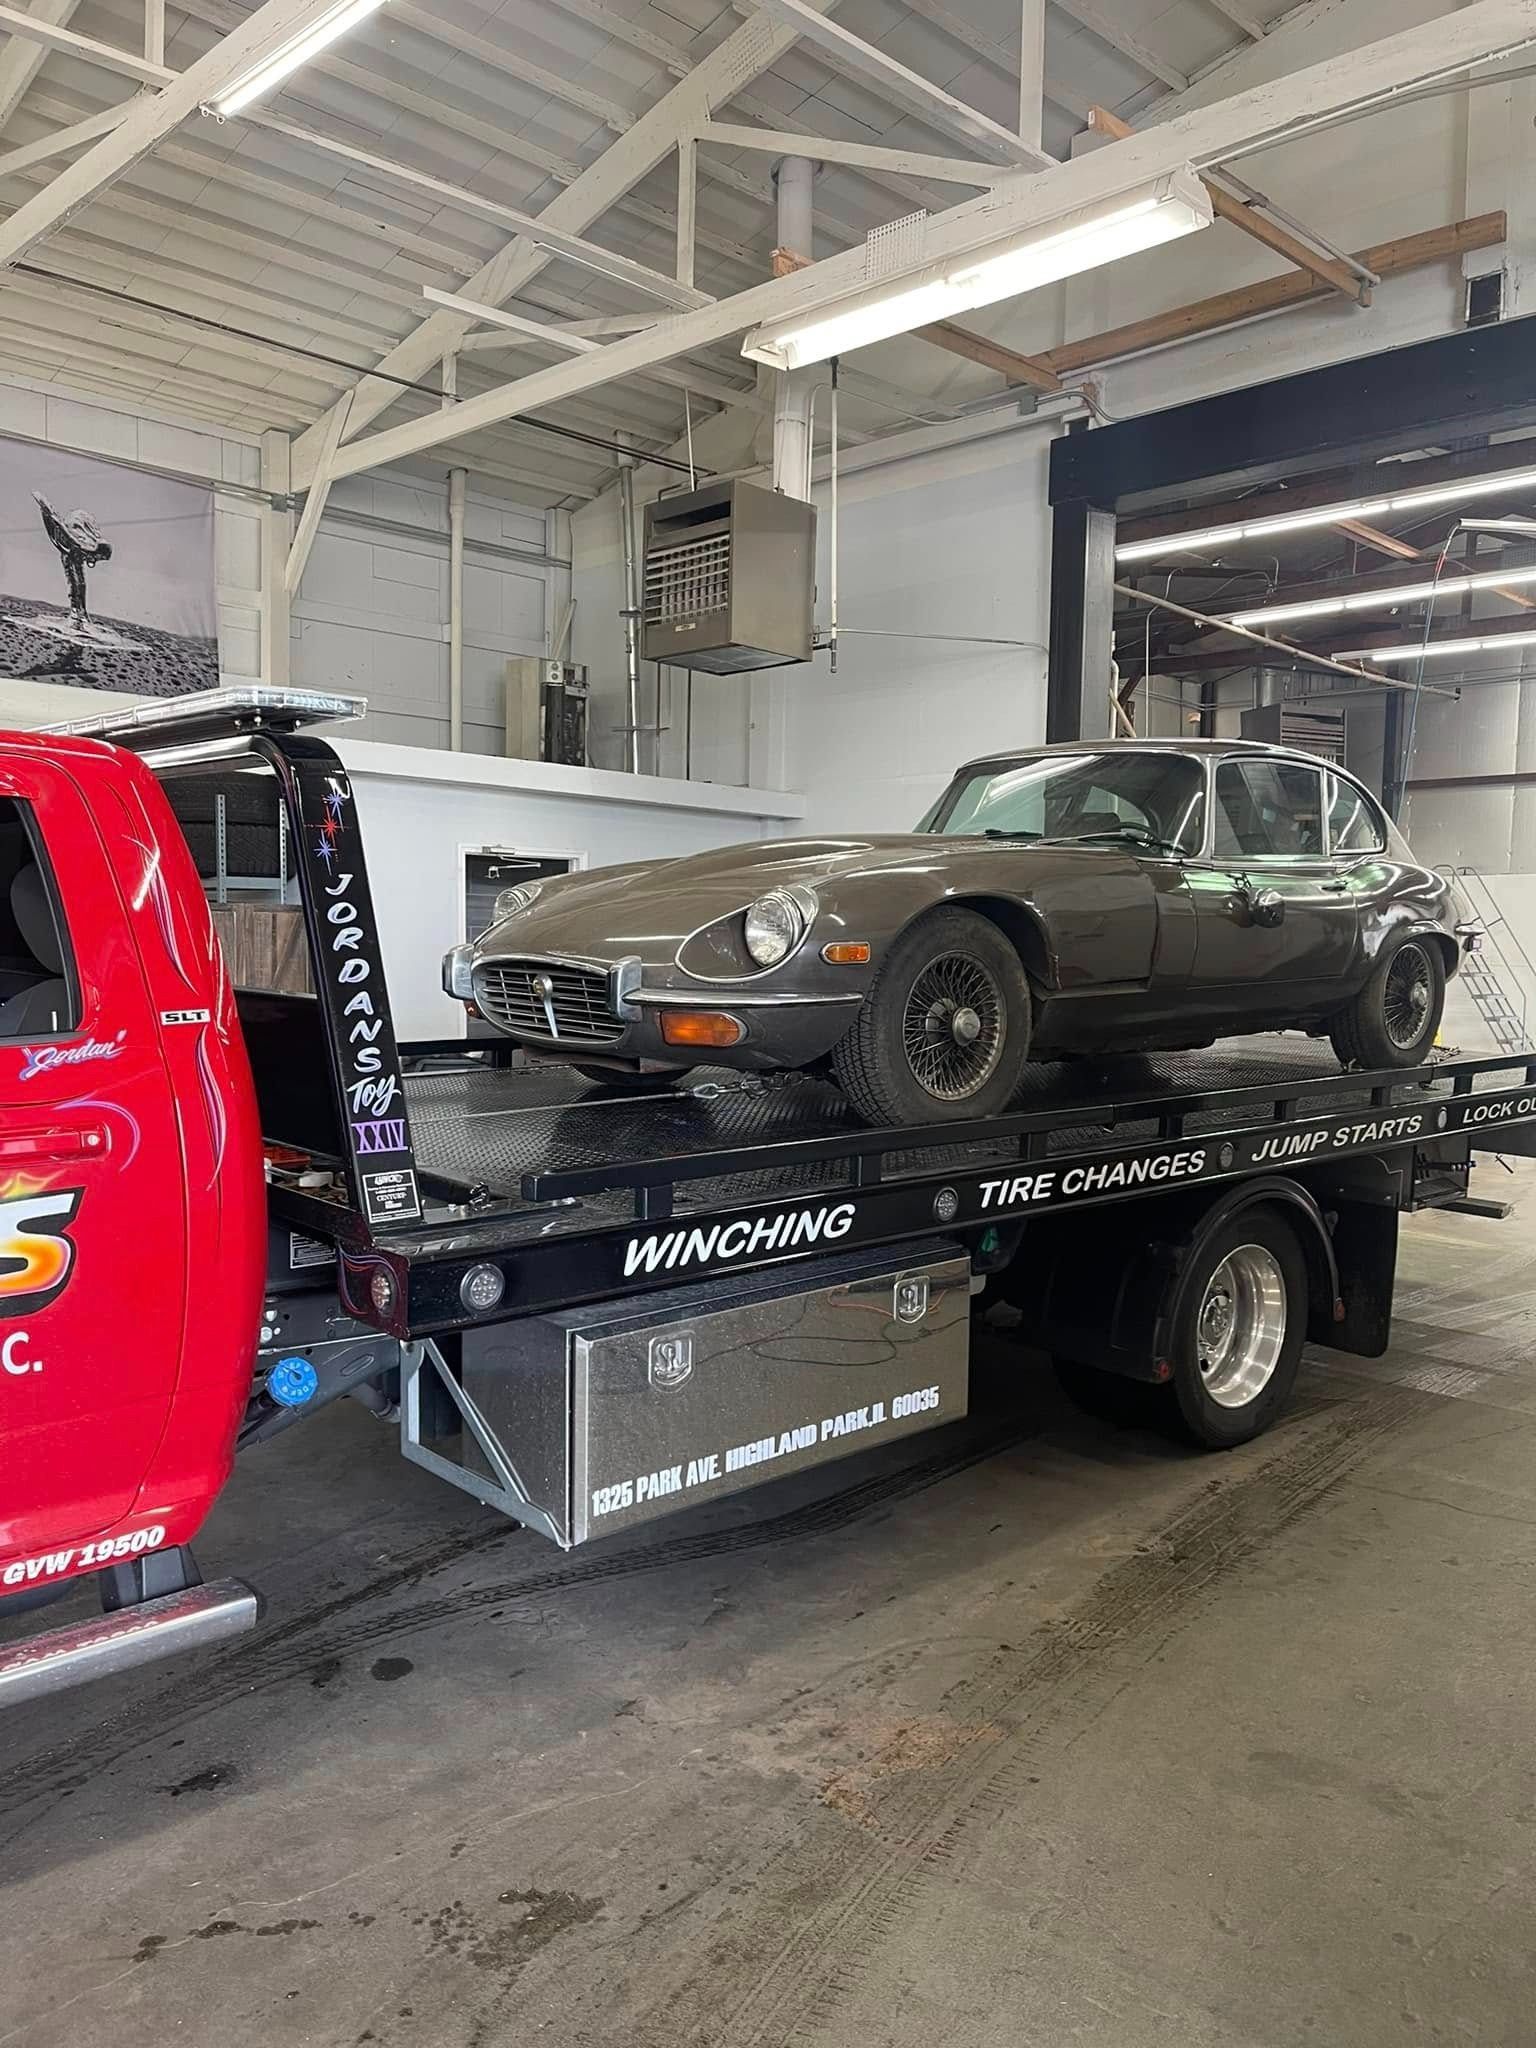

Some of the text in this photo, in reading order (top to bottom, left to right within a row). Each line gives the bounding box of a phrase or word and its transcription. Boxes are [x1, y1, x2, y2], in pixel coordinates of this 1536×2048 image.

[325, 873, 383, 1073] JORDANS
[165, 1011, 206, 1022] SLT
[347, 1074, 402, 1116] Toy
[1462, 1101, 1514, 1124] LOCK
[351, 1119, 408, 1153] XXIV
[1251, 1115, 1422, 1162] JUMP STARTS
[978, 1150, 1206, 1208] TIRE CHANGES
[623, 1203, 856, 1277] WINCHING
[591, 1480, 633, 1517] 1325
[636, 1465, 682, 1504] PARK
[725, 1424, 817, 1473] HIGHLAND
[892, 1385, 940, 1420] 60035
[3, 1525, 166, 1585] GVW 19500
